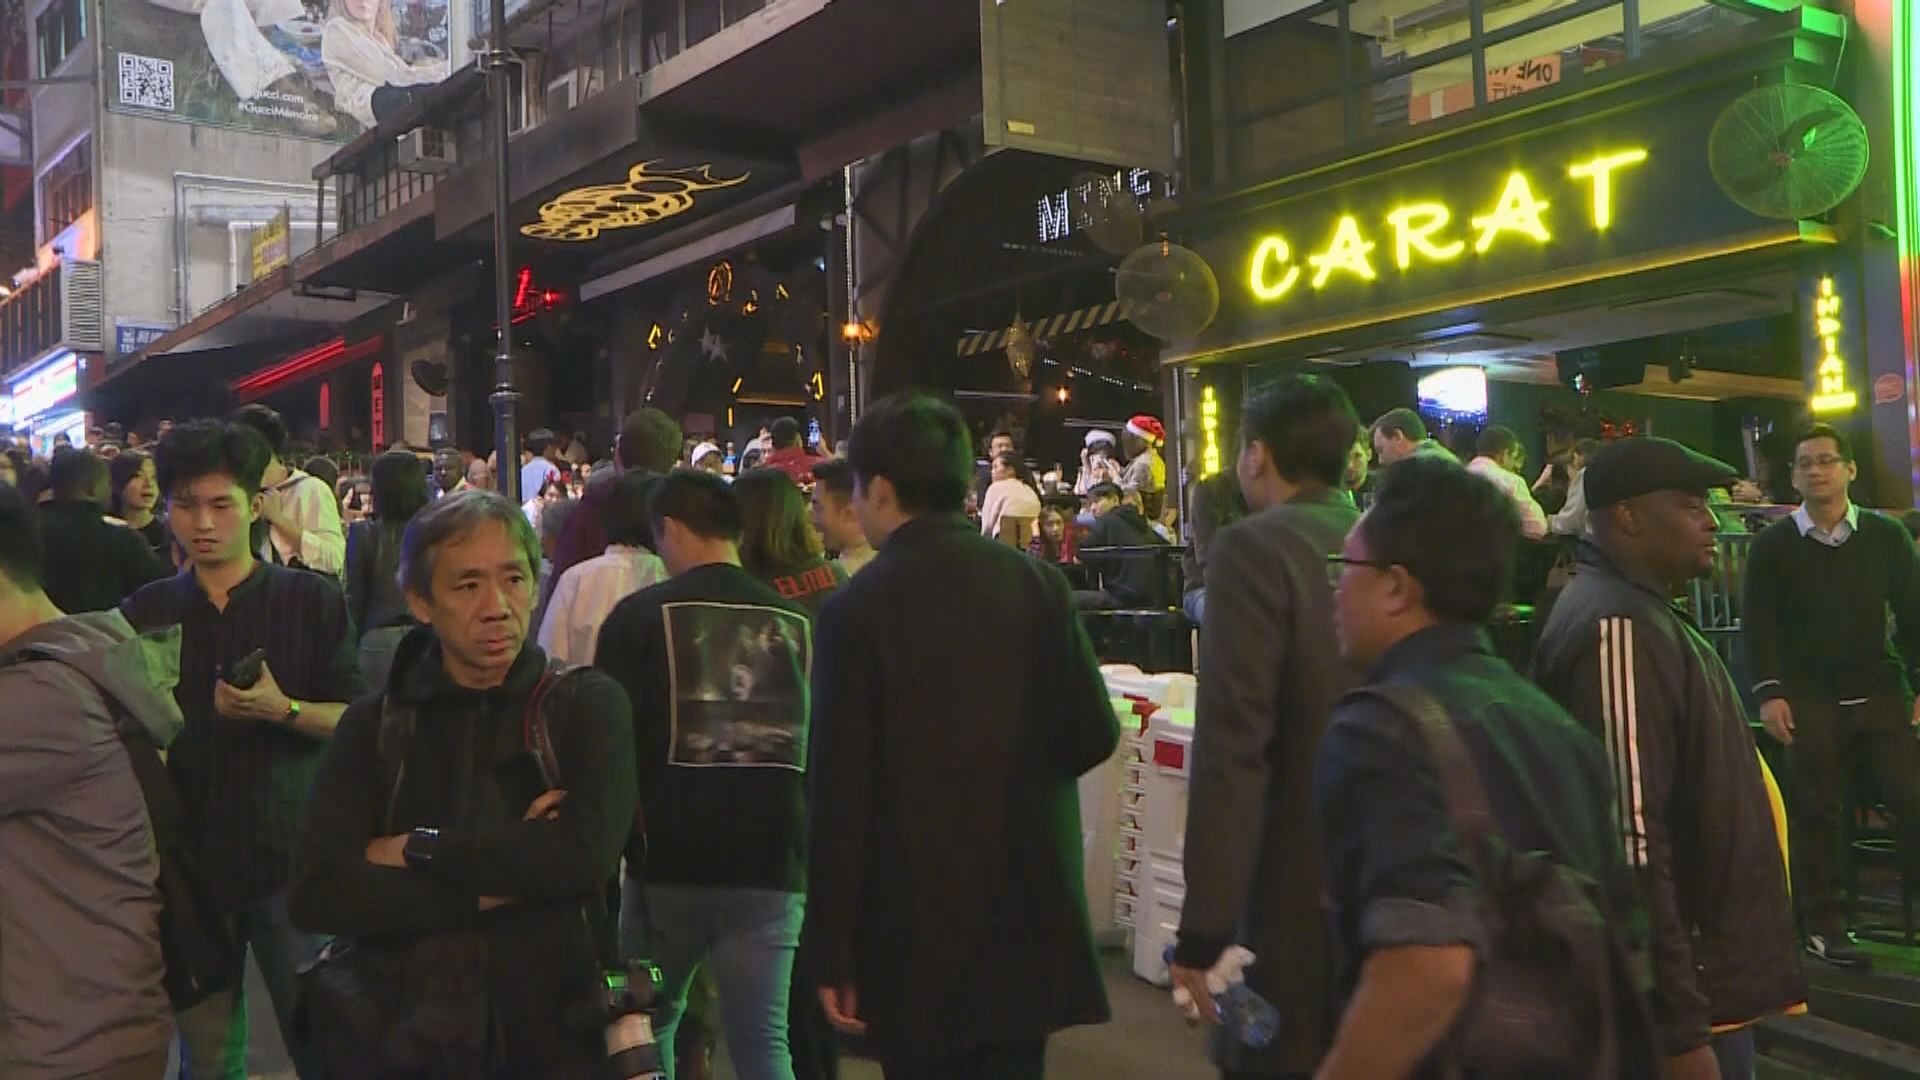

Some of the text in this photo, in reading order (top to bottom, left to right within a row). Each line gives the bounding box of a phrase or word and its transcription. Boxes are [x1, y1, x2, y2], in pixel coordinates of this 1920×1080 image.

[253, 88, 304, 104] gucci.com
[1248, 148, 1648, 300] CARAT
[1815, 277, 1844, 393] INDIAN
